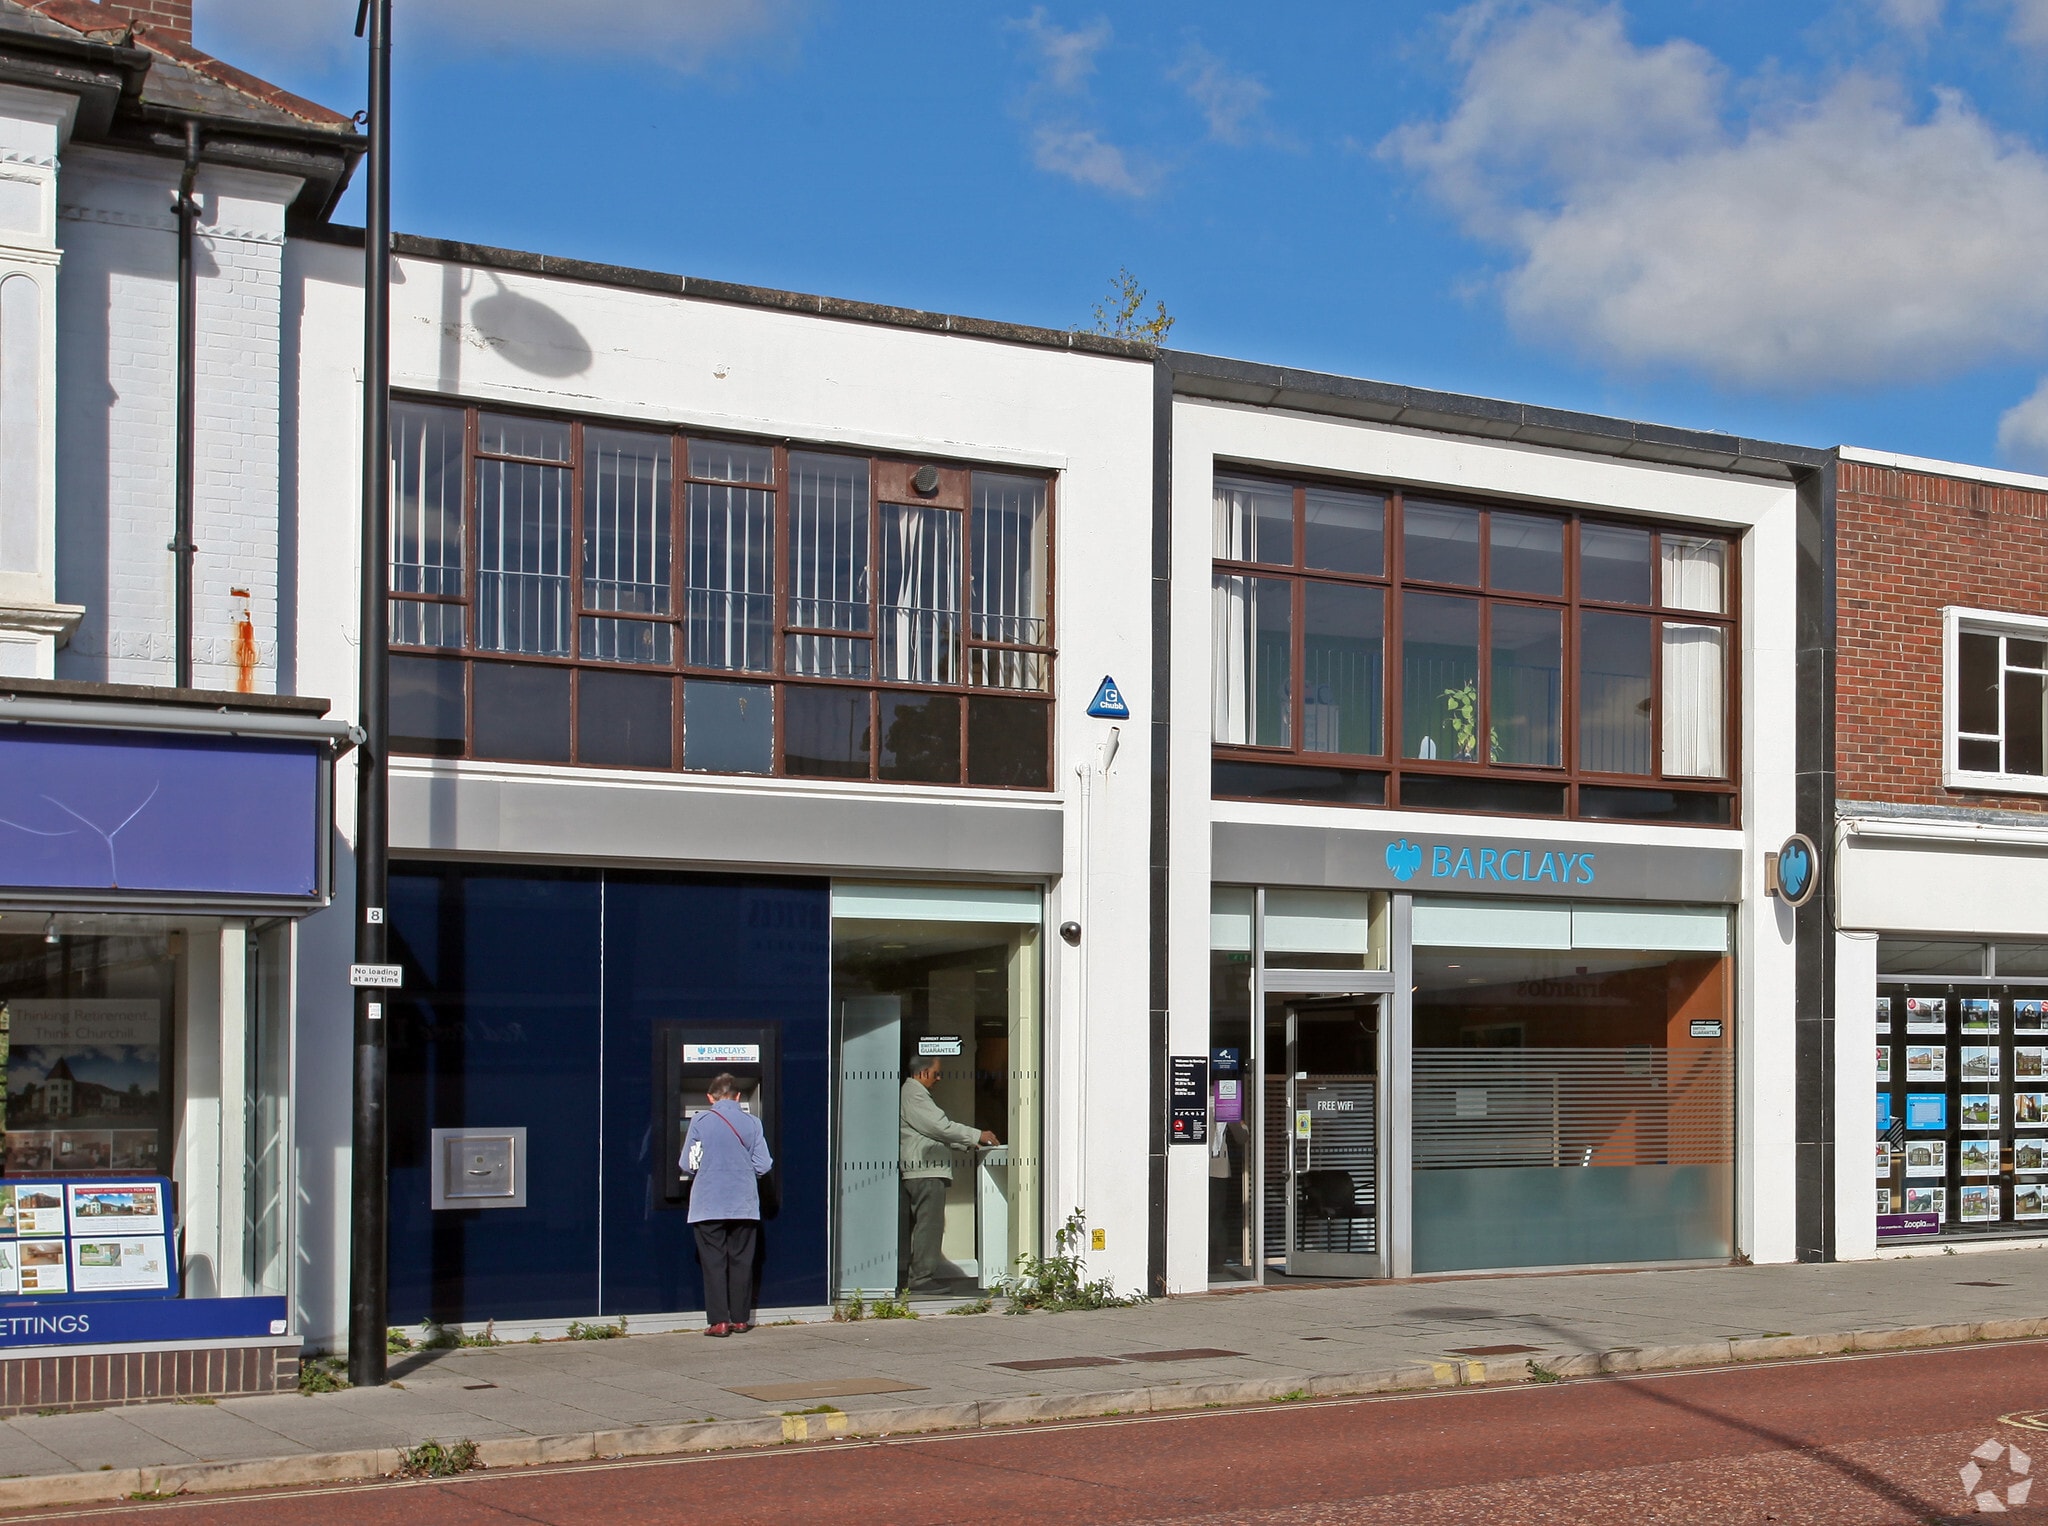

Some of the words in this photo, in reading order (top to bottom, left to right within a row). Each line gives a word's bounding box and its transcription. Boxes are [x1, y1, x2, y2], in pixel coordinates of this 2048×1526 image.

[1100, 701, 1124, 710] Chubb
[1431, 845, 1596, 884] BARCLAYS
[371, 910, 380, 921] 8
[354, 967, 367, 975] No
[369, 967, 398, 977] loading
[364, 976, 379, 984] any
[14, 1008, 71, 1025] Thinking
[35, 1027, 71, 1040] Think
[75, 1027, 137, 1040] Churchill.
[707, 1046, 746, 1055] BARCLAYS
[1317, 1100, 1336, 1111] FREE
[1337, 1100, 1354, 1111] WiFi
[0, 1314, 90, 1336] ETTINGS
